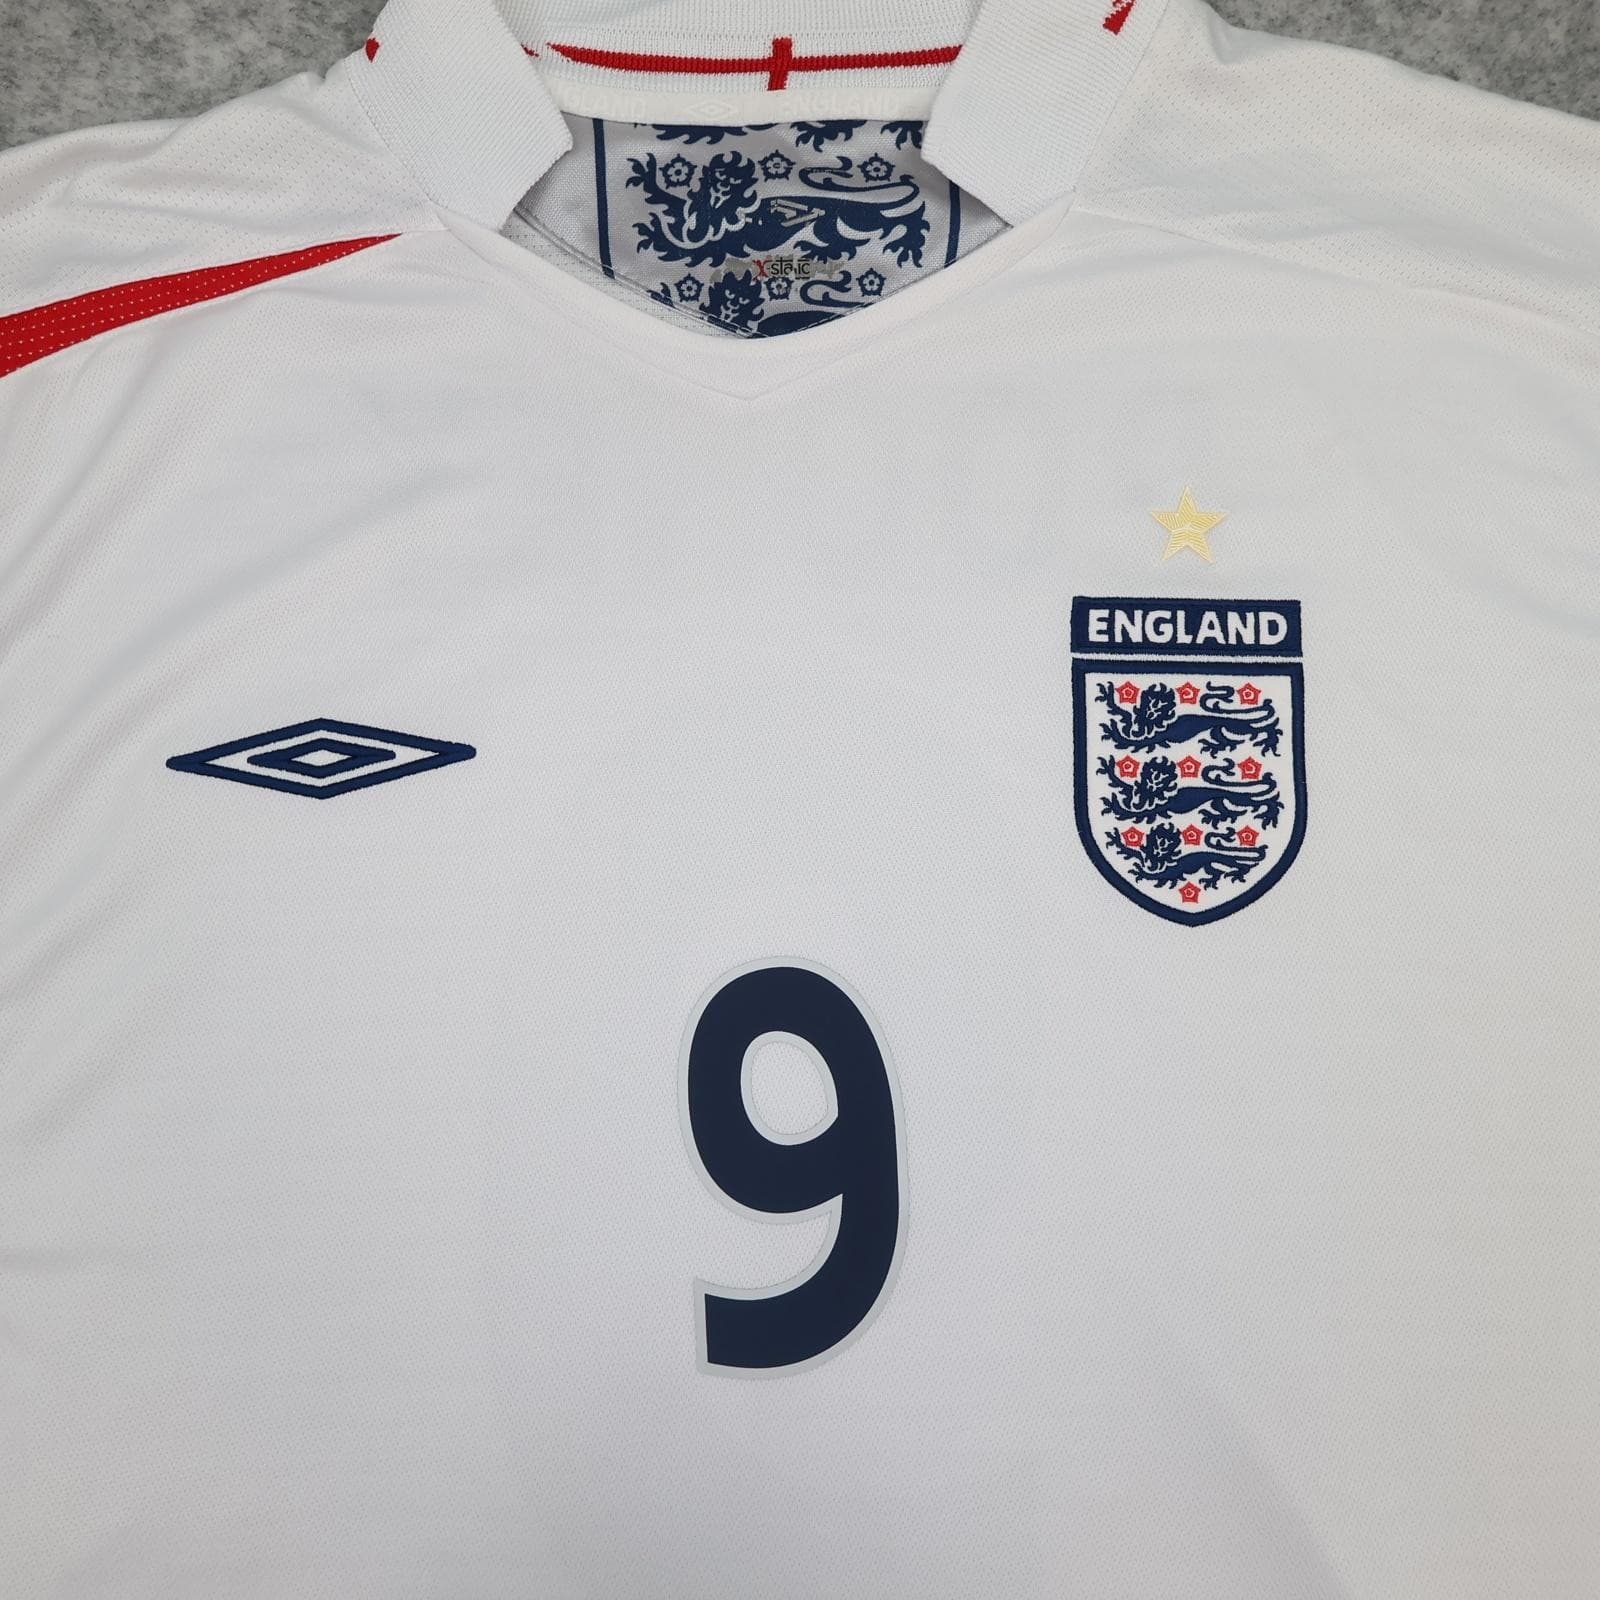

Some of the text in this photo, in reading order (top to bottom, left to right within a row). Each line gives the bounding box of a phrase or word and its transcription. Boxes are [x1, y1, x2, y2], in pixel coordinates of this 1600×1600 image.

[559, 87, 646, 118] GLAND
[1088, 609, 1288, 645] ENGLAND
[684, 963, 903, 1373] 9
